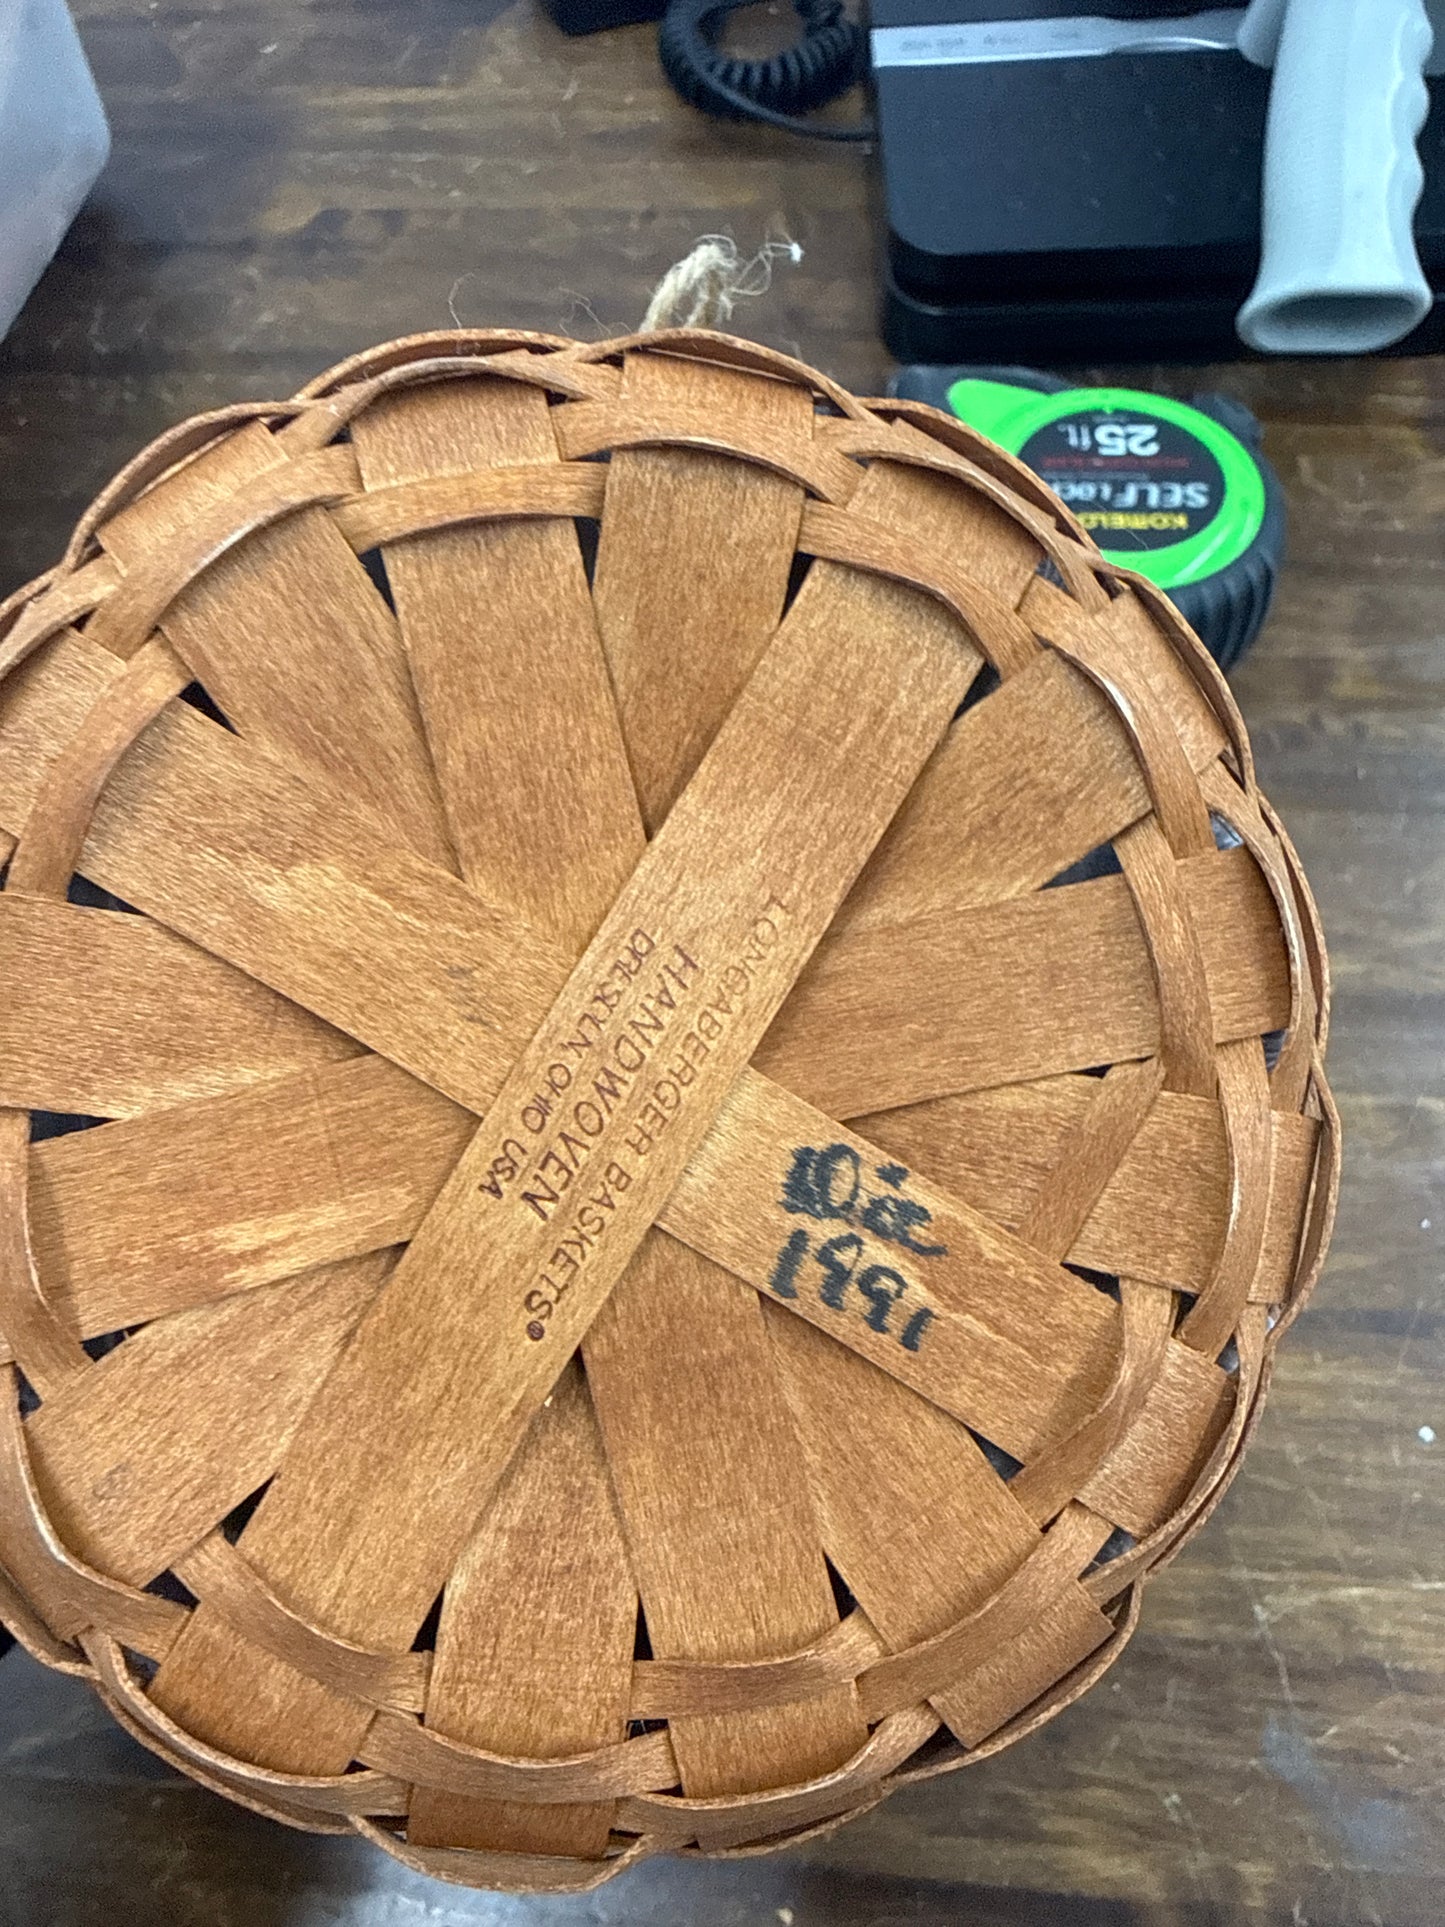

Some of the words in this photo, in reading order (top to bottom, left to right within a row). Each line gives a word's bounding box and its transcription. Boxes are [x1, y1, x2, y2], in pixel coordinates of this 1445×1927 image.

[1094, 423, 1160, 457] 25
[1076, 512, 1189, 530] KOMELO
[1112, 481, 1210, 508] SELF
[625, 896, 792, 1157] LONGABERGER
[519, 943, 699, 1222] HANDWOVEN
[521, 1062, 573, 1135] OHIO
[478, 1137, 530, 1201] USA
[768, 1226, 940, 1353] 1991
